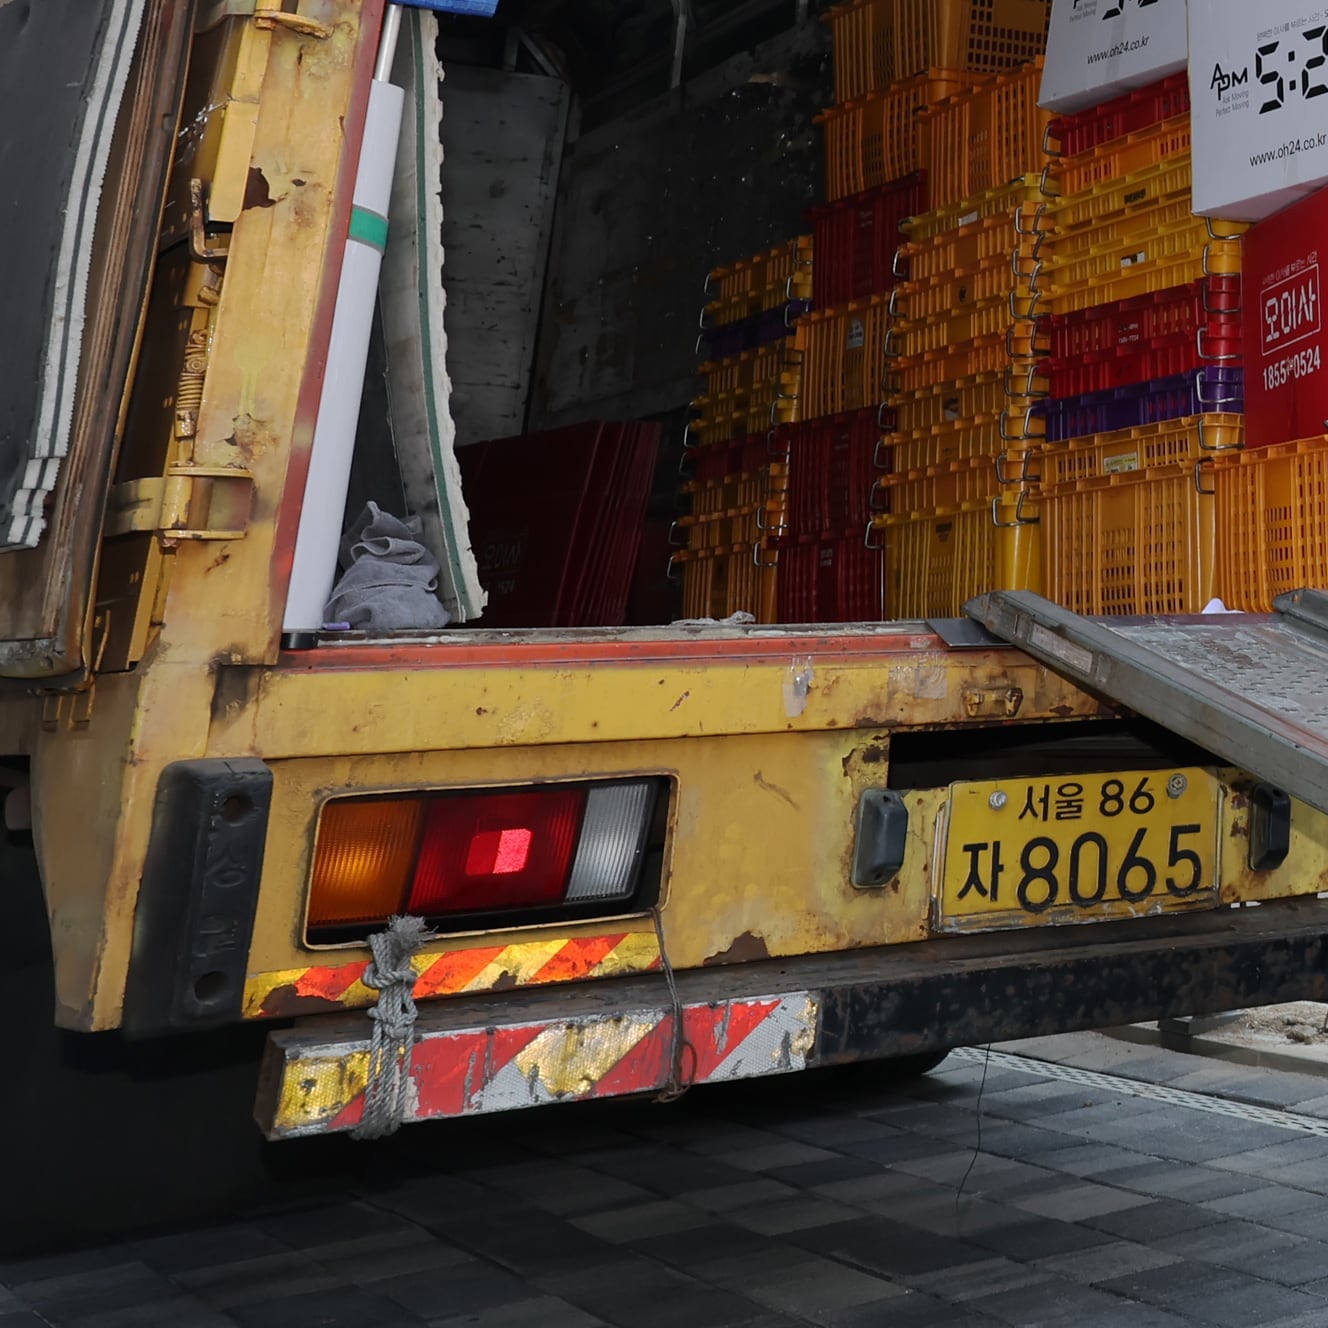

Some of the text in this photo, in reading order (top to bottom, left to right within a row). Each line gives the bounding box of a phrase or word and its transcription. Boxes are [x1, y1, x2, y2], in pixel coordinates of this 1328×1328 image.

[1087, 36, 1150, 64] www.oh24.co.kr
[1250, 133, 1327, 167] www.oh24.co.kr
[1265, 278, 1316, 343] 오이사
[1018, 777, 1155, 822] 서울 86
